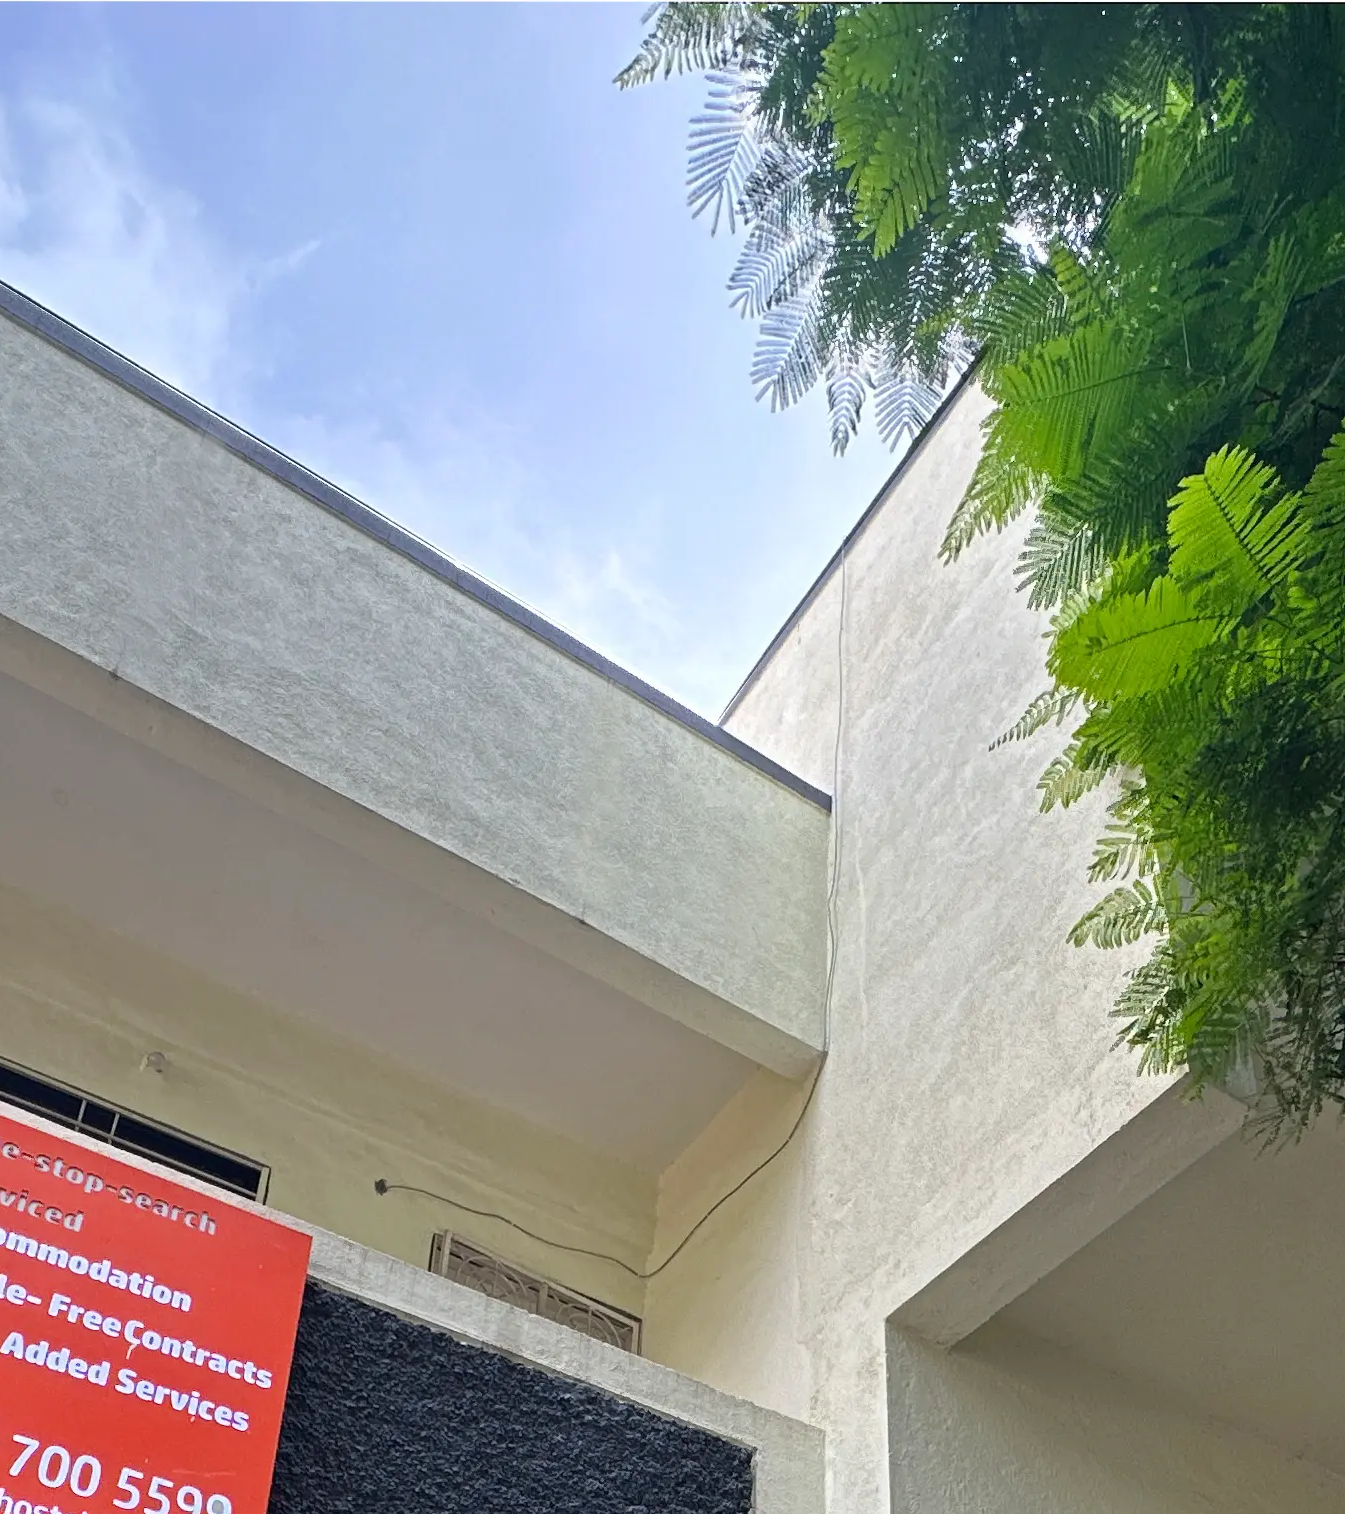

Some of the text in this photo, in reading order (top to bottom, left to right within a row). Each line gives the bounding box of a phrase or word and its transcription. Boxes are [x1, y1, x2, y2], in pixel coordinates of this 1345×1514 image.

[0, 1332, 111, 1387] Added
[115, 1368, 250, 1432] Services
[8, 1434, 102, 1498] 700
